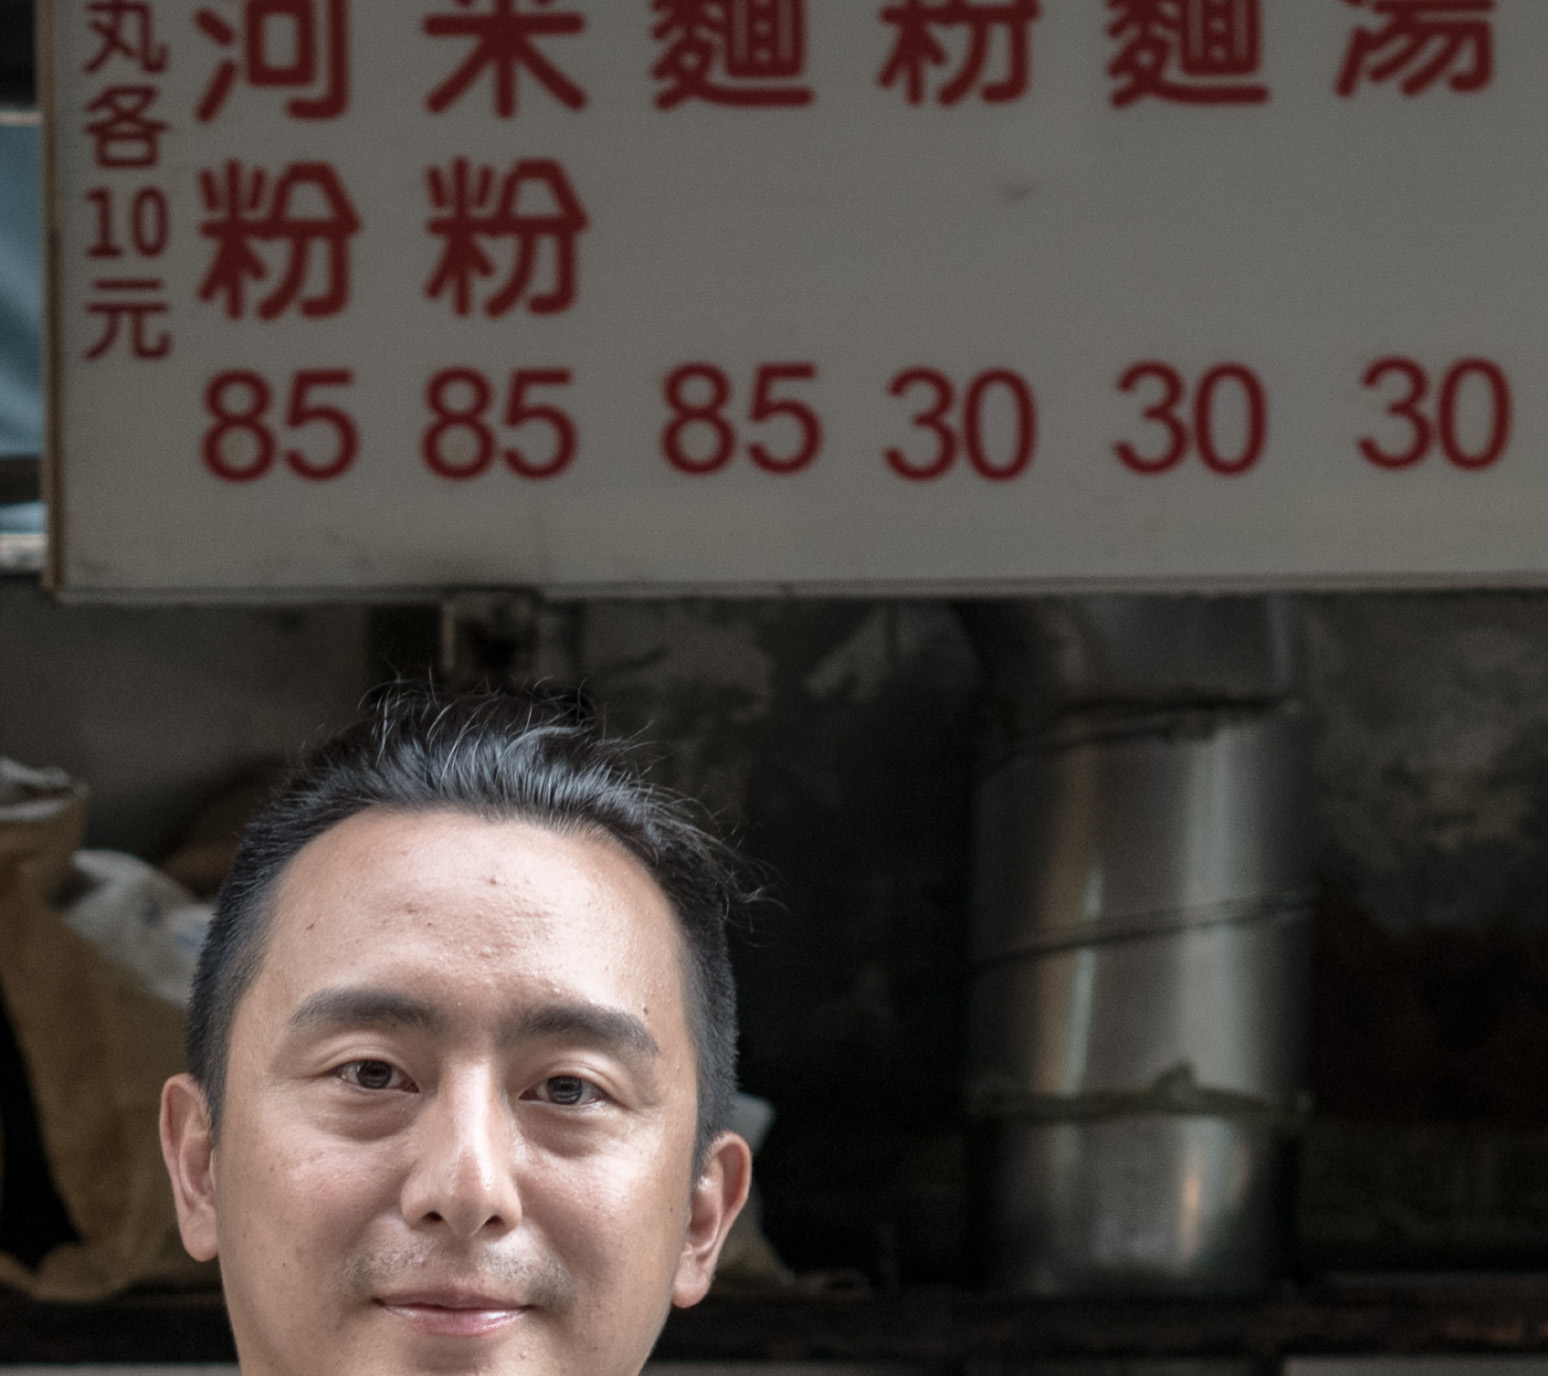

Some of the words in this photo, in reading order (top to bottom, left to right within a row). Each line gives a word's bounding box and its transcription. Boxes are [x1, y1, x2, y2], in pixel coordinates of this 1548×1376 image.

[193, 0, 362, 322] 河粉
[422, 0, 590, 319] 米粉
[201, 369, 360, 484] 85
[420, 366, 579, 481] 85
[660, 362, 824, 476] 85
[883, 367, 1038, 483] 30
[1114, 361, 1269, 477] 30
[1357, 355, 1514, 471] 30
